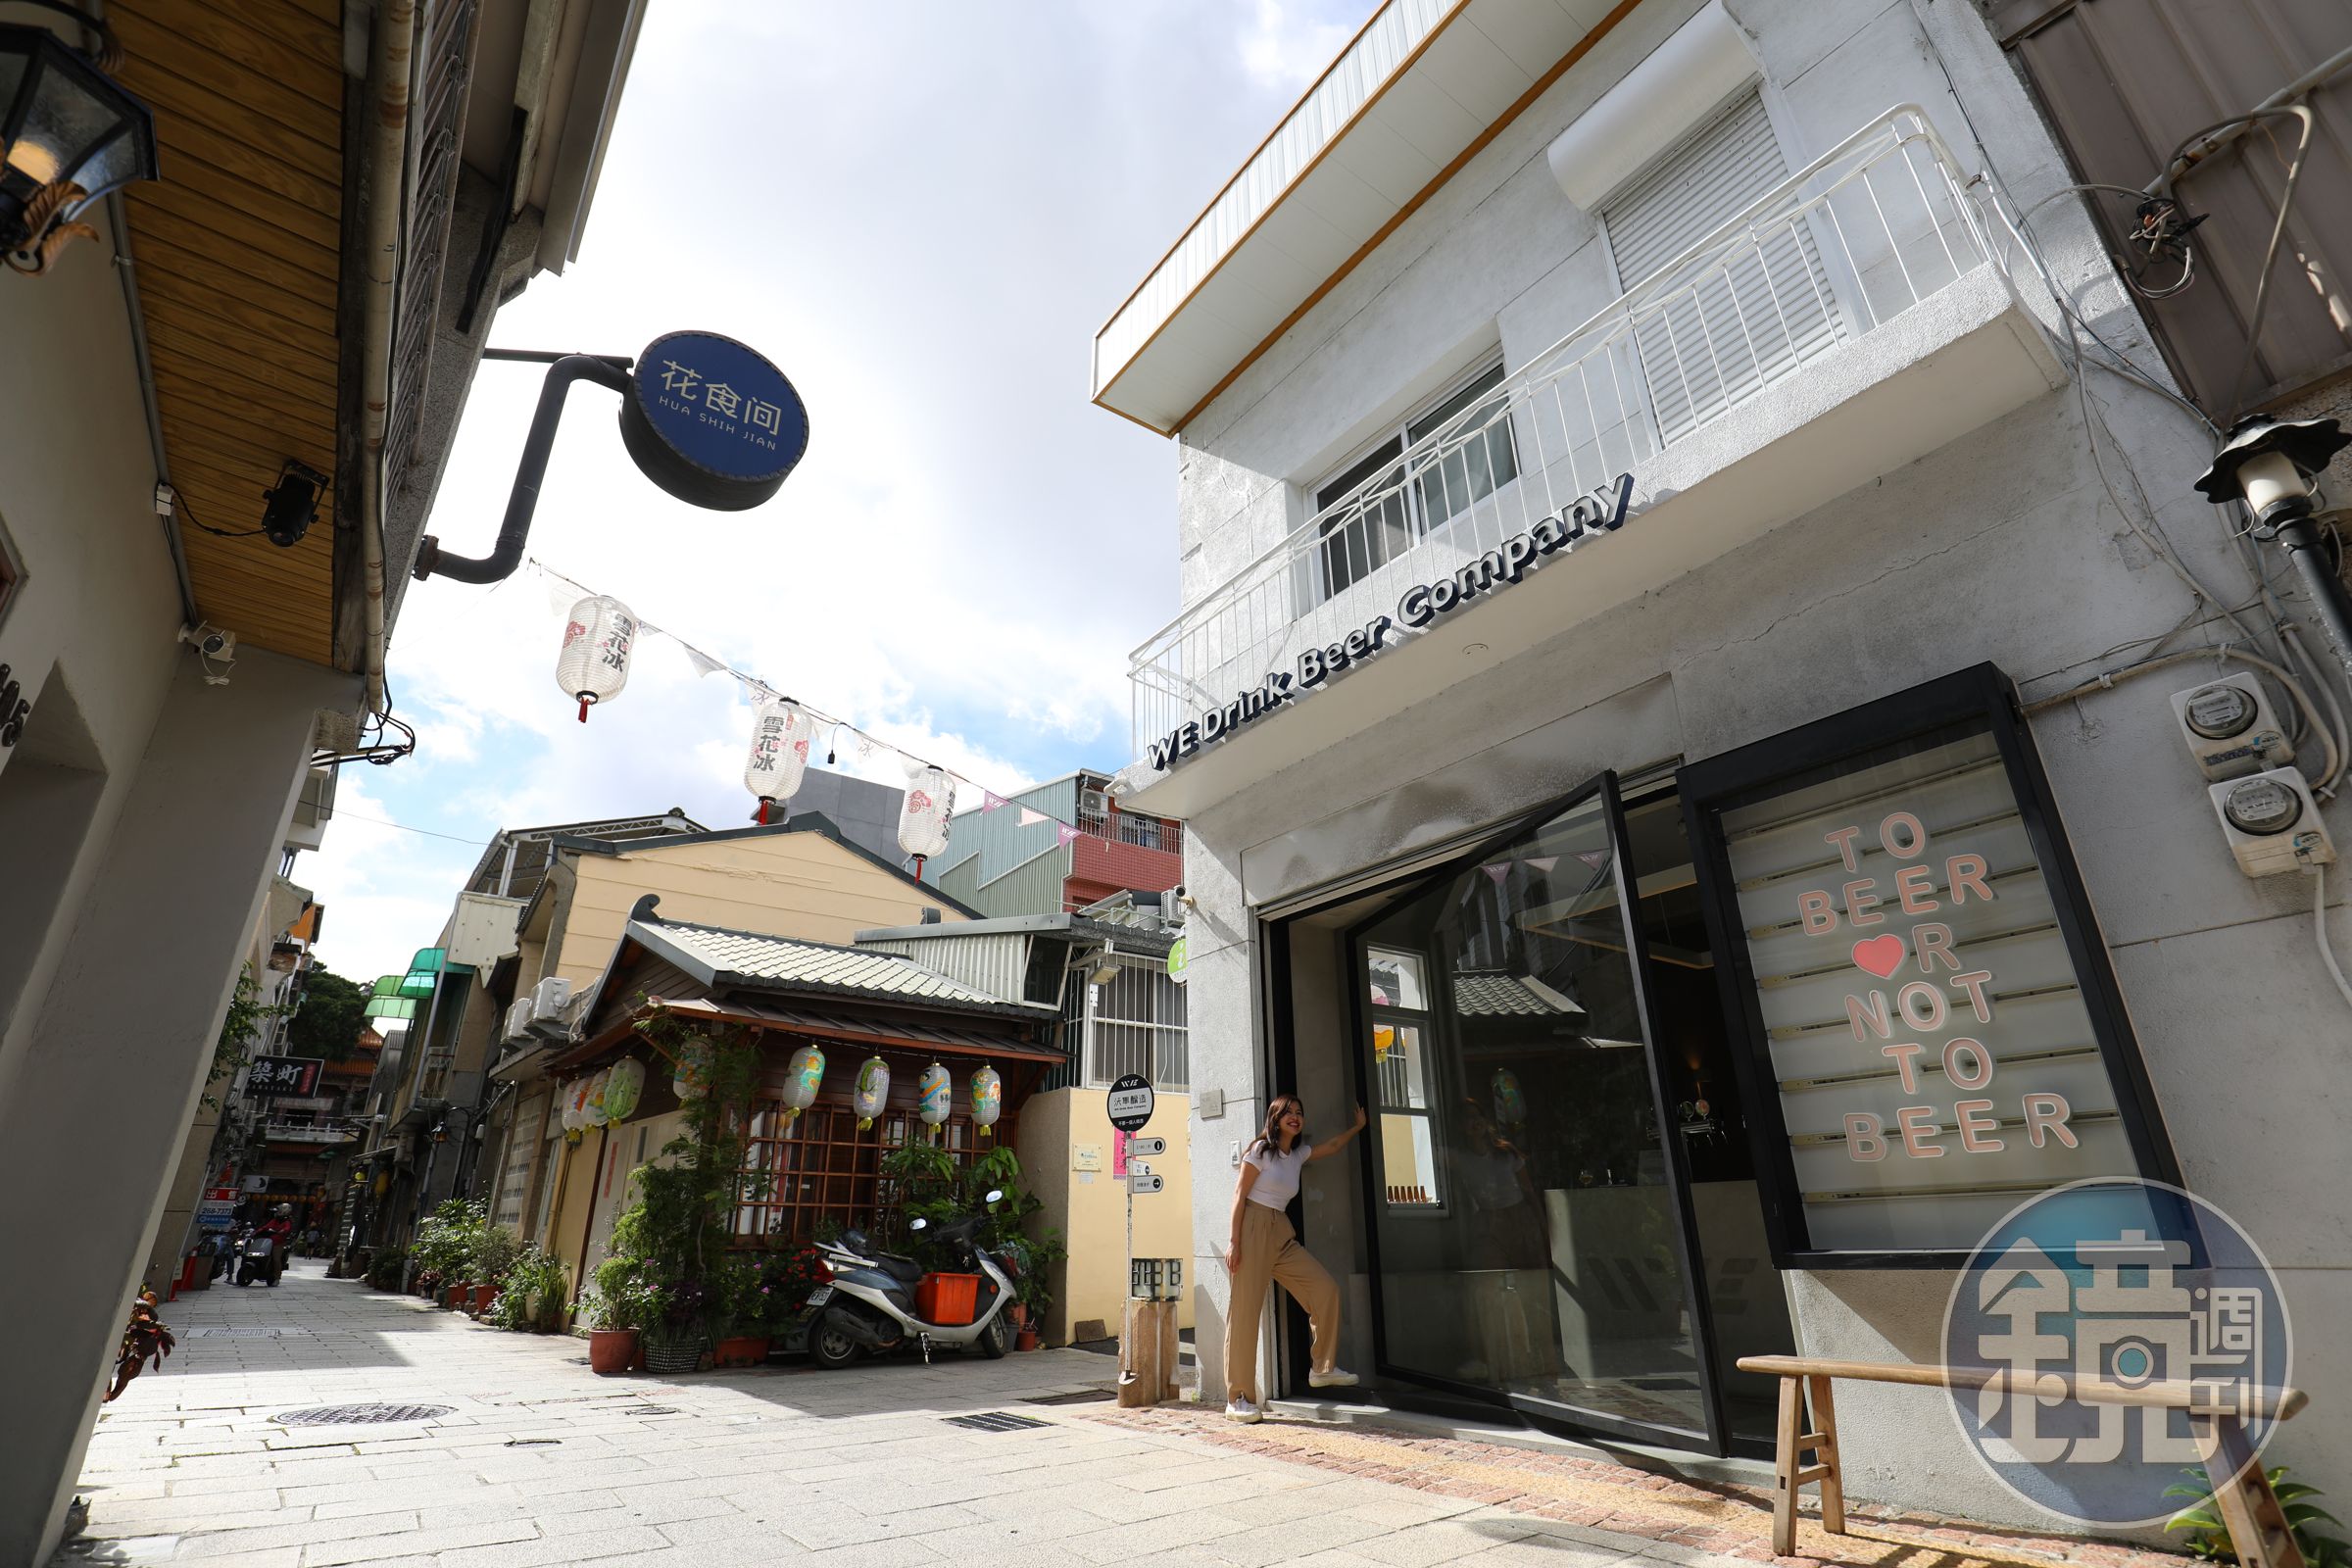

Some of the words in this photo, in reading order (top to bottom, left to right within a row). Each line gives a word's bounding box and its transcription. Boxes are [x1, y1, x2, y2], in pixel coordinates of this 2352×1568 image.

[659, 395, 690, 416] HUA
[699, 413, 736, 434] SHIH
[743, 431, 777, 451] JIAN
[661, 360, 782, 436] 花食间
[602, 612, 633, 673] 雪花冰
[1147, 720, 1200, 771] WE
[1200, 671, 1295, 744] Drink
[1297, 614, 1392, 688] Beer
[1396, 472, 1636, 628] Company
[753, 715, 784, 771] 雪花冰
[1824, 811, 1927, 872] TO
[1797, 854, 1994, 936] BEER
[1844, 969, 1993, 1043] NOT
[1881, 1037, 1994, 1095] TO
[1843, 1093, 2080, 1162] BEER
